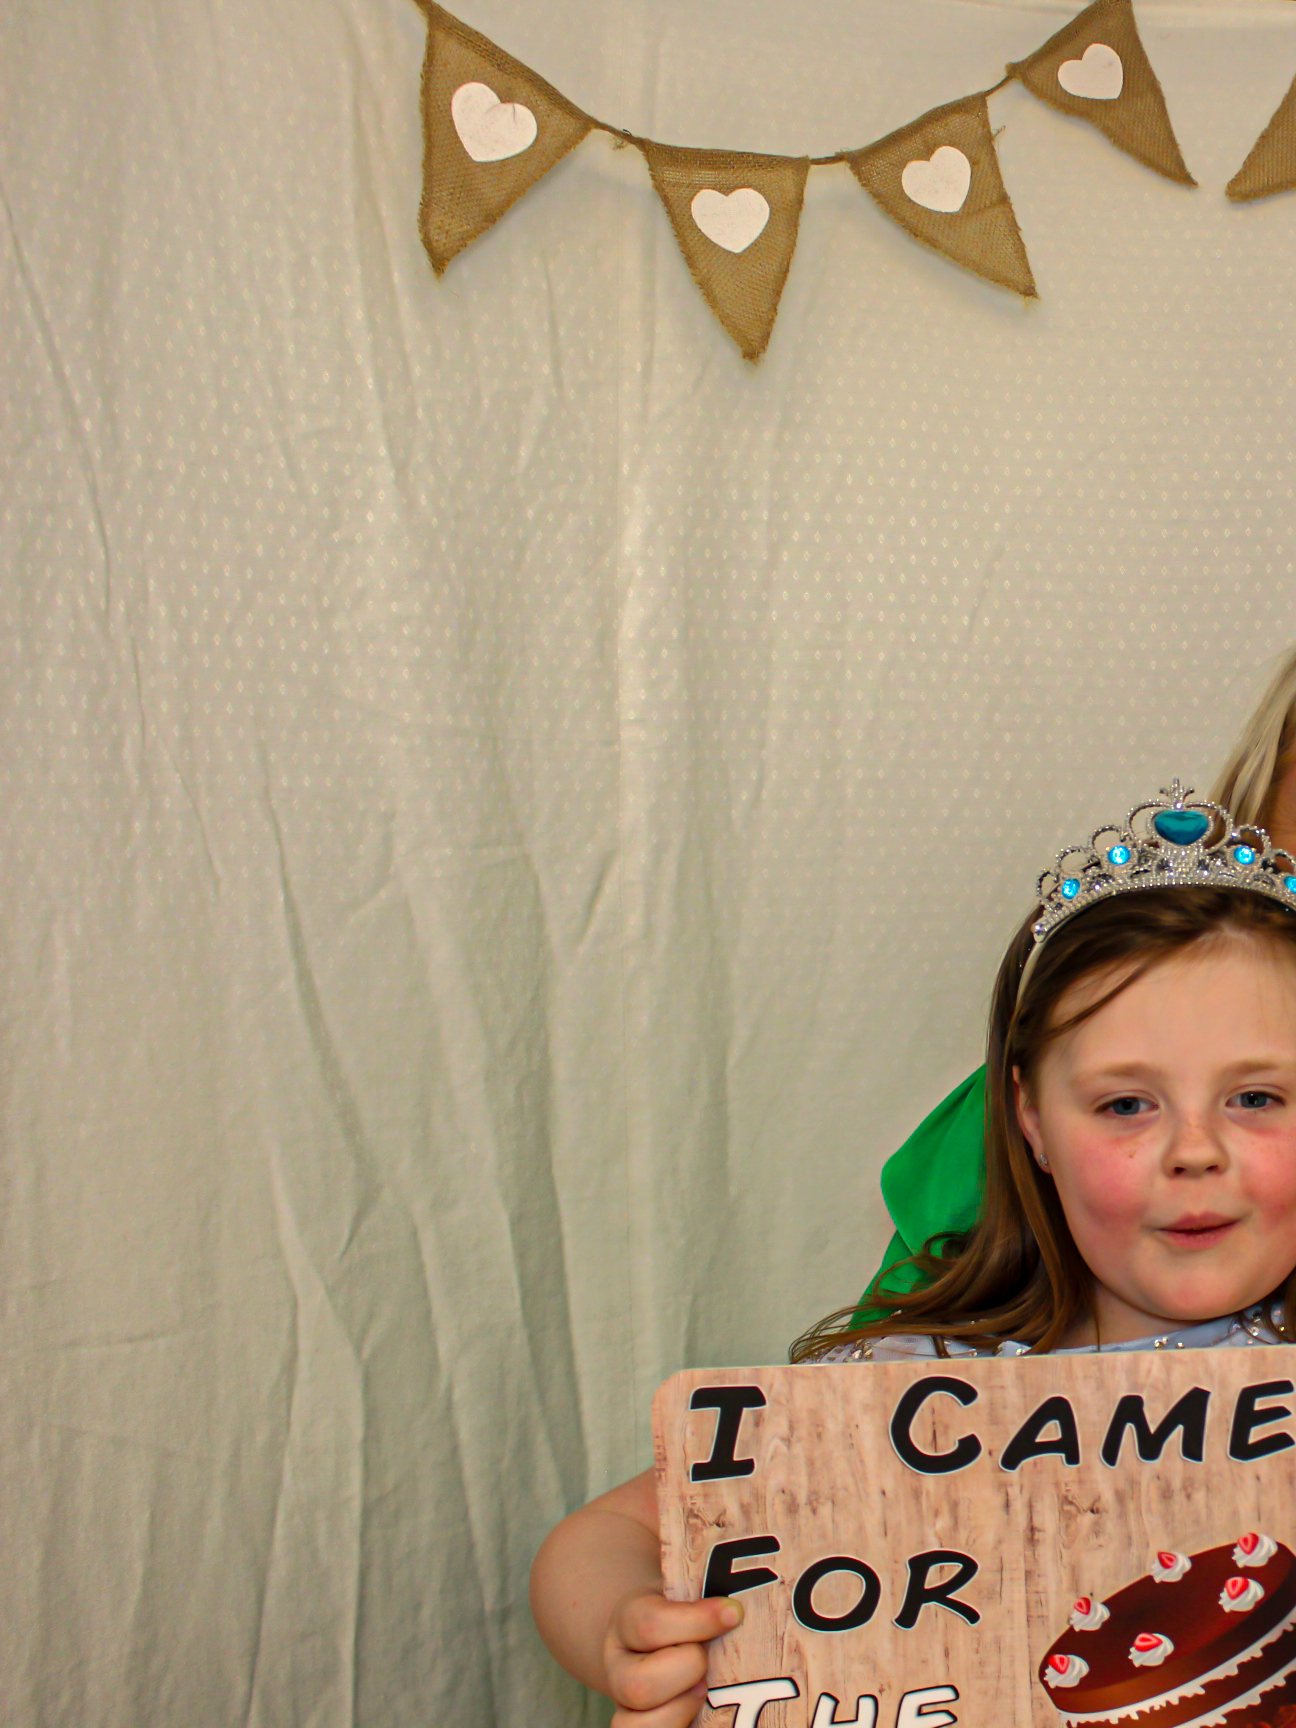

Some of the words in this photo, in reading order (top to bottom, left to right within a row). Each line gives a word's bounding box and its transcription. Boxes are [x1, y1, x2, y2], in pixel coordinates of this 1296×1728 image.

[689, 1385, 768, 1483] I
[889, 1375, 1296, 1476] CAME
[702, 1535, 981, 1633] FOR
